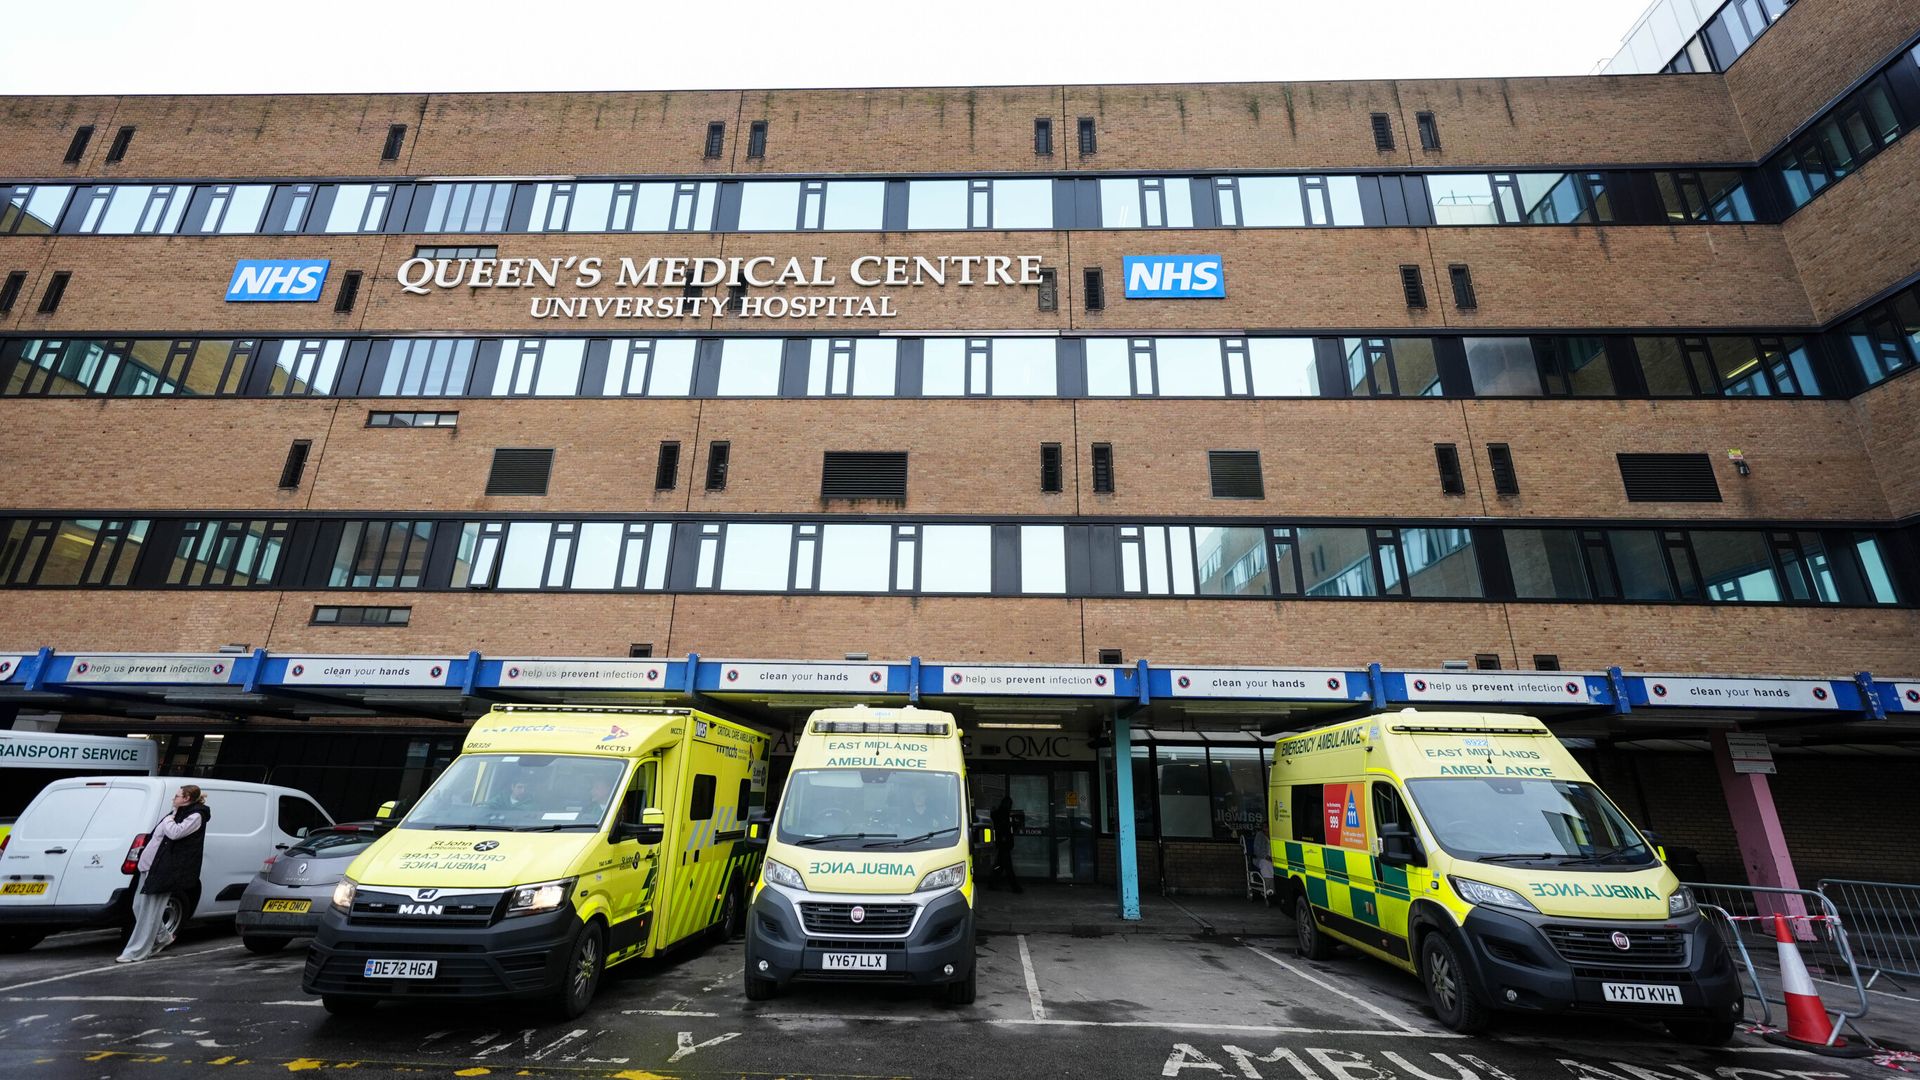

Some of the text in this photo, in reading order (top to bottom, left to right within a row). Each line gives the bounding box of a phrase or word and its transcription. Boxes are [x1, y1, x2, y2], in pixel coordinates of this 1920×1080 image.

[230, 265, 324, 295] NHS
[397, 254, 1044, 296] QUEEN'S MEDICAL CENTRE
[1128, 261, 1220, 291] NHS
[529, 295, 897, 319] UNIVERSITY HOSPITAL
[90, 664, 110, 673] help
[128, 665, 167, 674] prevent
[169, 664, 211, 673] infection
[323, 666, 410, 677] clean your hands
[522, 668, 644, 679] help us prevent infection
[759, 671, 849, 682] clean your hands
[965, 674, 1092, 685] help us prevent infection
[1212, 678, 1306, 689] clean your hands
[1429, 681, 1452, 692] help
[1472, 683, 1514, 693] prevent
[1518, 683, 1563, 693] infection
[1690, 686, 1790, 698] clean your hands
[828, 741, 928, 752] EAST MIDLANDS
[1005, 735, 1071, 759] QMC
[1281, 726, 1364, 757] EMERGENCY AMBULANCE
[595, 744, 626, 752] MCCTS
[1425, 748, 1540, 760] EAST MIDLANDS
[82, 747, 139, 762] SERVICE
[827, 757, 927, 768] AMBULANCE
[1440, 765, 1556, 778] AMBULANCE
[1329, 815, 1339, 828] 999
[1347, 811, 1357, 825] 111
[398, 904, 444, 915] MAN
[828, 954, 882, 968] YY67 LLX
[373, 961, 433, 977] DE72 HGA
[1609, 985, 1677, 1002] YX70 KVH
